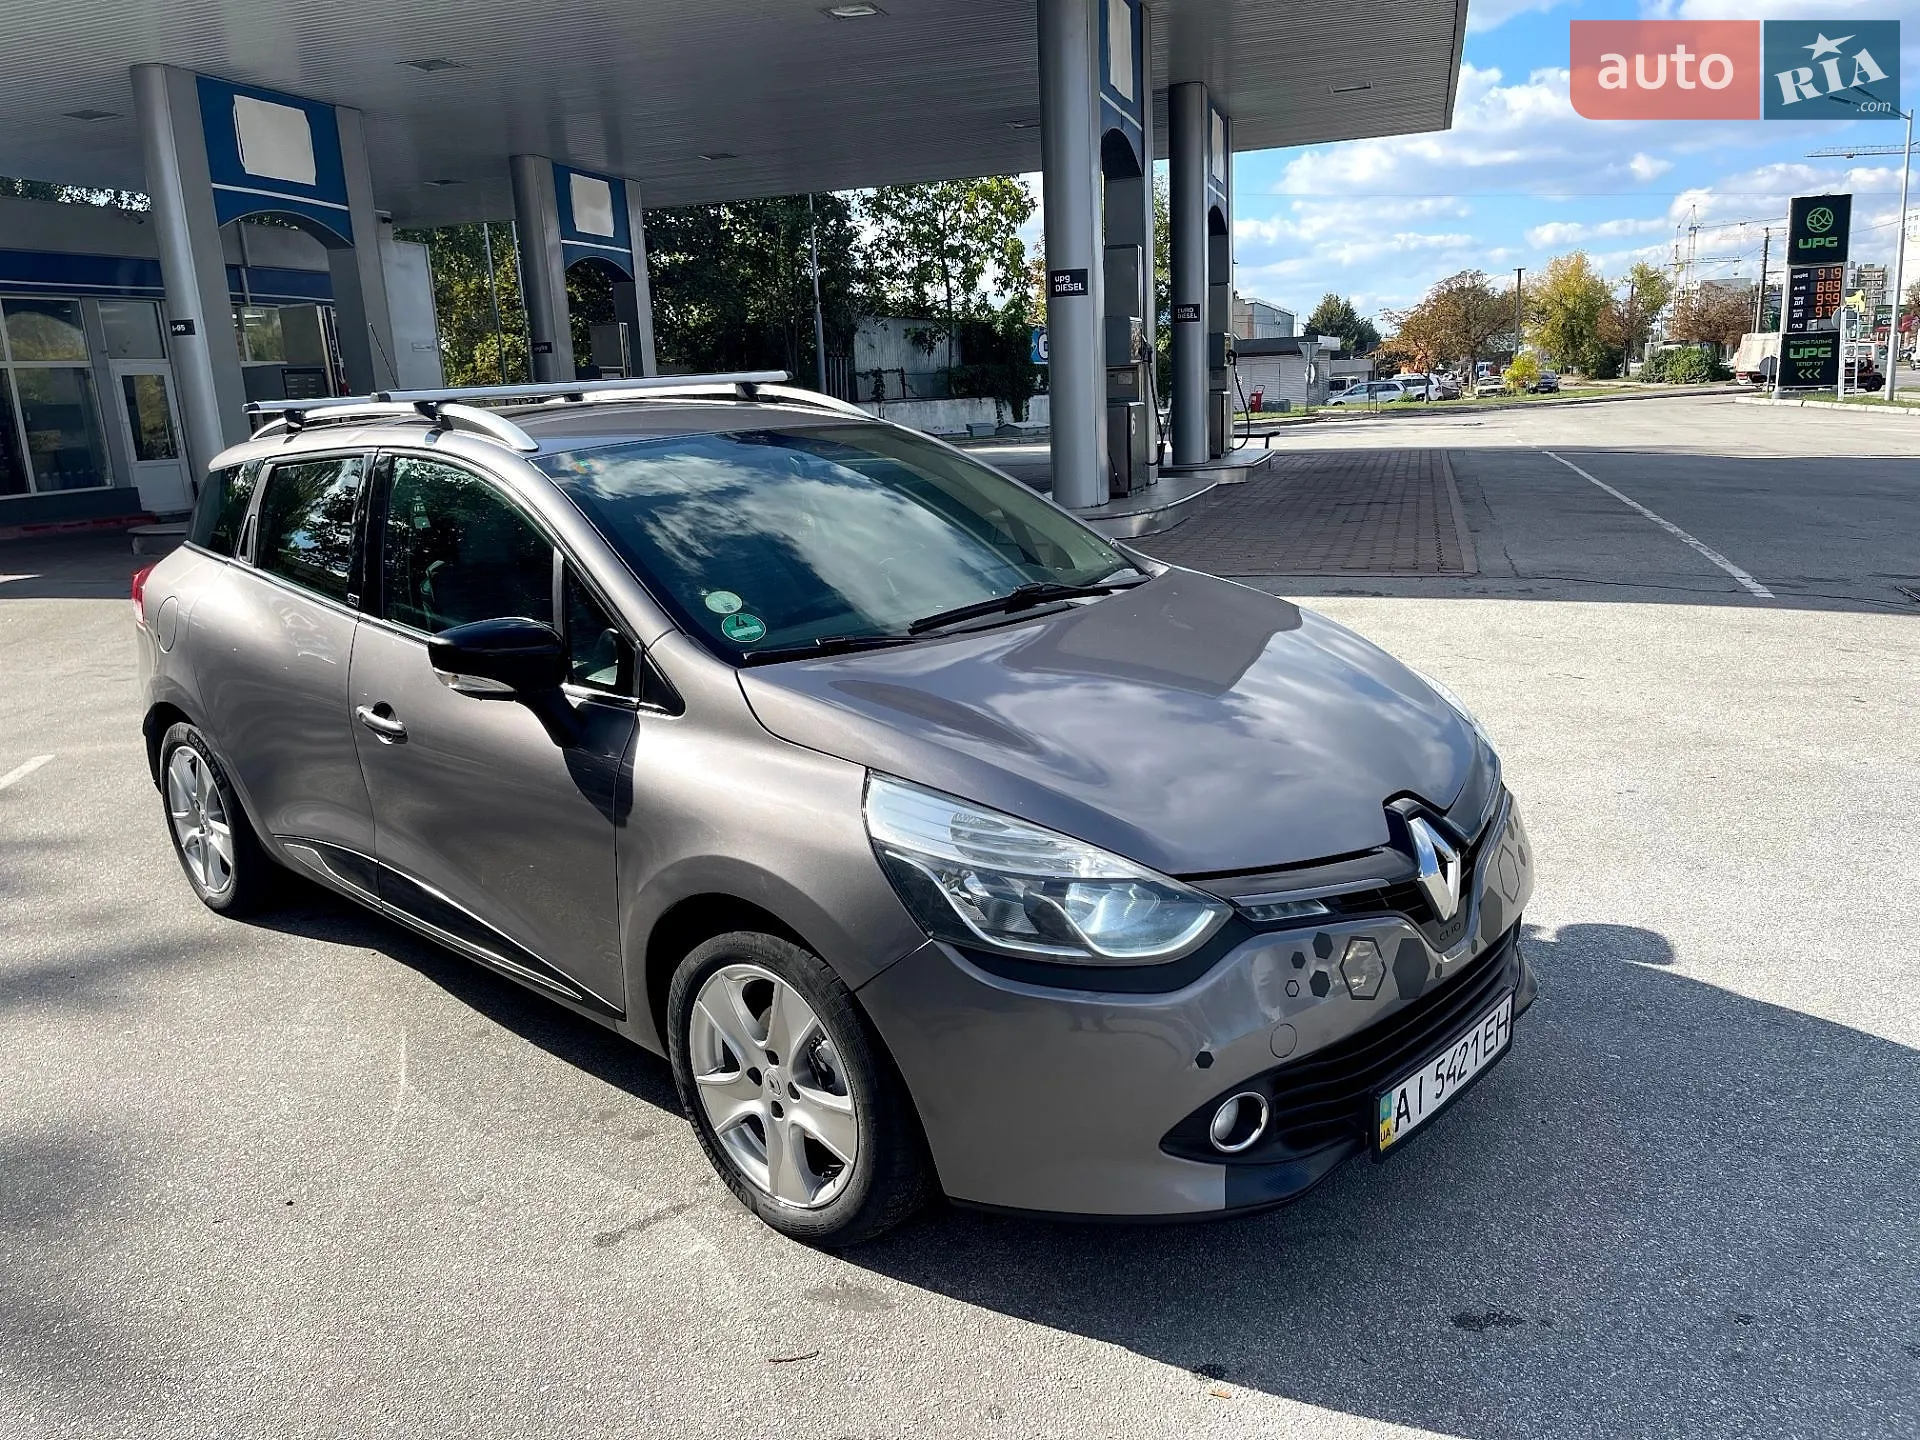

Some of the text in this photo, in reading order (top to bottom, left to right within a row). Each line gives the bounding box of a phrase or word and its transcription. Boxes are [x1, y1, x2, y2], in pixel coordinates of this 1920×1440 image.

[1799, 237, 1838, 249] UPG
[1055, 275, 1070, 283] upg
[1055, 283, 1084, 292] DIESEL
[1789, 347, 1832, 359] UPG
[1394, 1003, 1510, 1133] AI 5421 EH
[1380, 1127, 1391, 1143] UA
